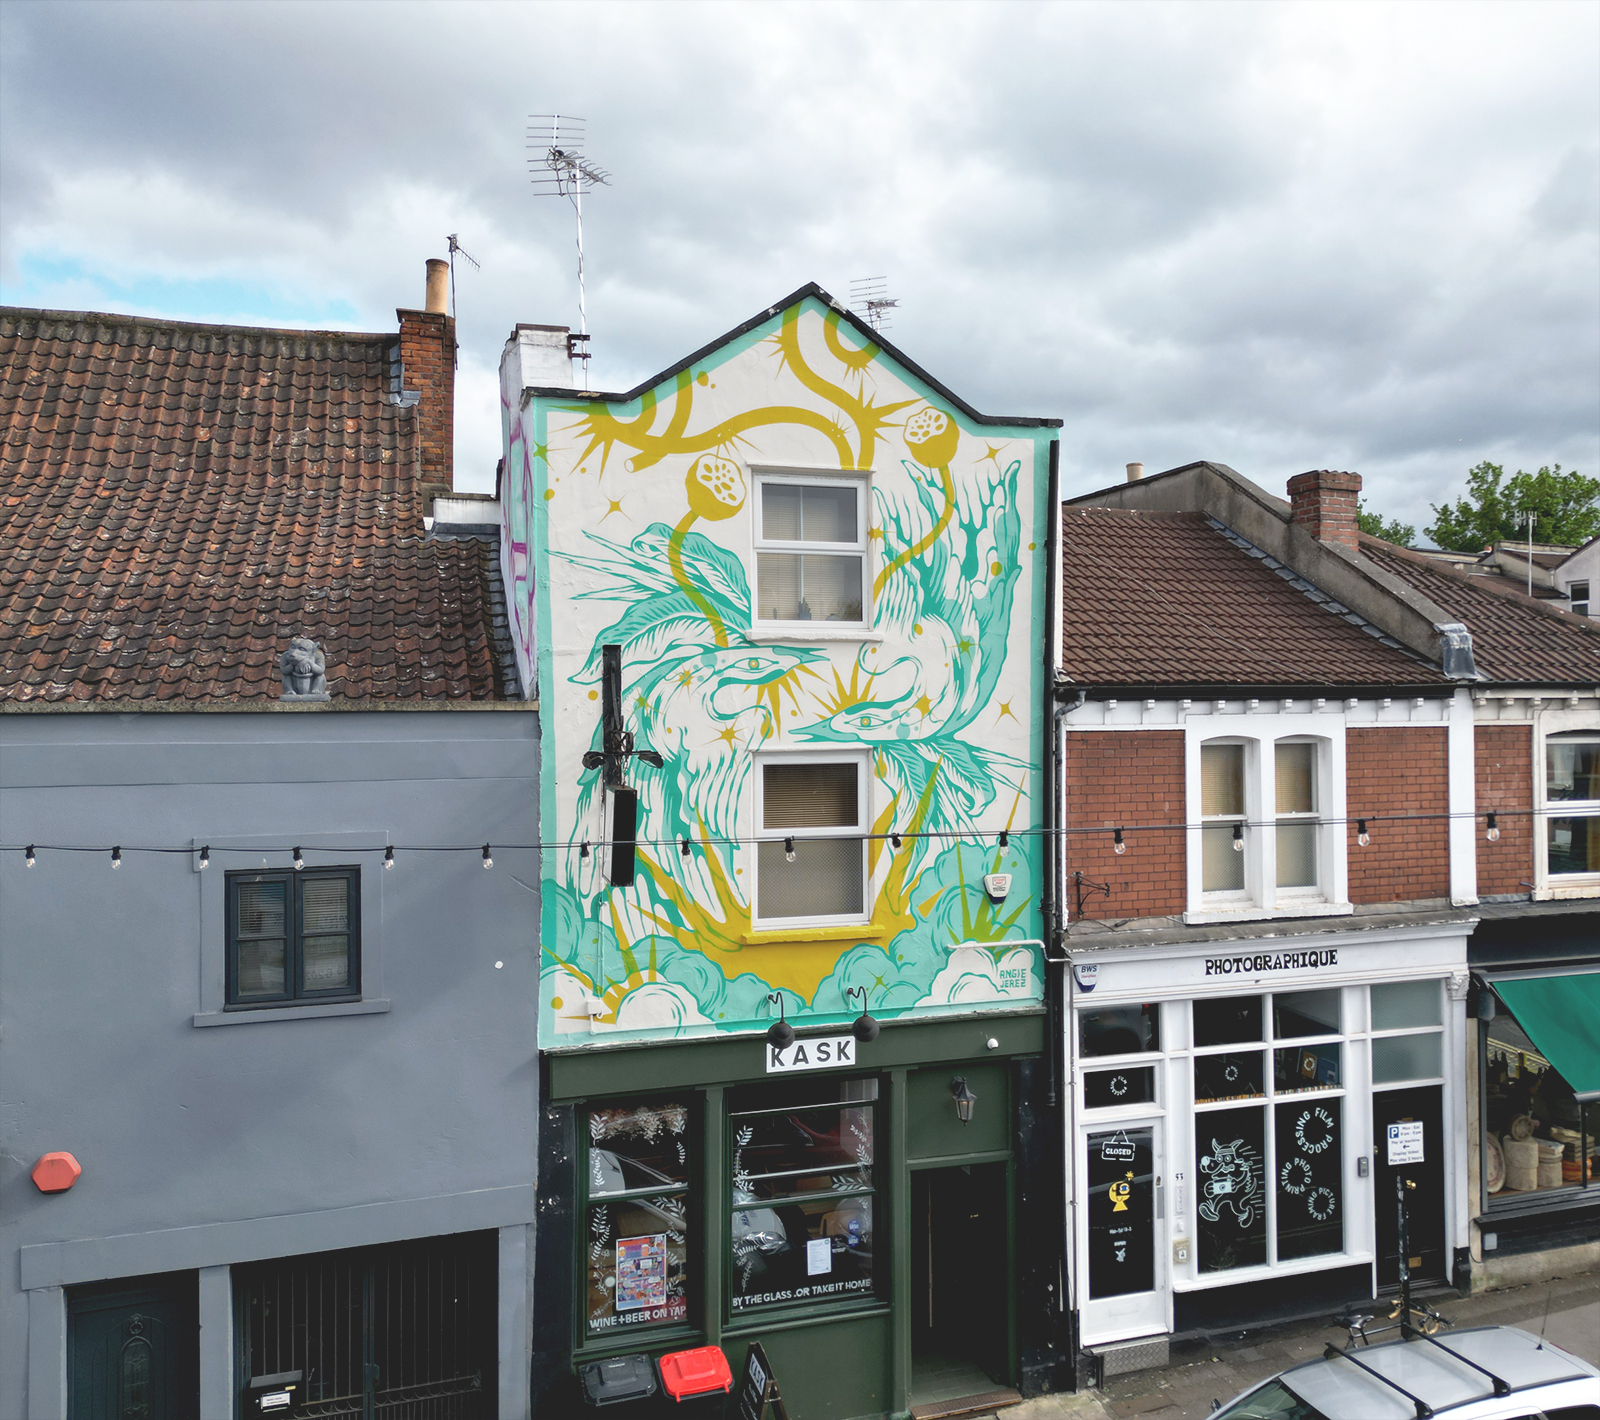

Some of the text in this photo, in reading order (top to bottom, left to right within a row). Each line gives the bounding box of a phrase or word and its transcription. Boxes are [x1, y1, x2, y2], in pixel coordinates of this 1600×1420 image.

[999, 968, 1027, 980] ANGIE
[1081, 965, 1098, 973] BWS
[1205, 949, 1338, 976] PHOTOGRAPHIQUE
[999, 979, 1026, 988] JEREZ
[771, 1040, 851, 1068] KASK
[1295, 1107, 1335, 1154] FILM PROCESSING
[1105, 1147, 1132, 1156] CLOSED
[1280, 1157, 1312, 1195] PHOTO PRINTING
[1307, 1187, 1336, 1221] PICTURE FRAMING
[732, 1297, 743, 1307] BY
[744, 1293, 762, 1305] THE
[763, 1290, 792, 1302] GLASS
[845, 1278, 871, 1290] HOME
[652, 1309, 668, 1319] ON
[669, 1305, 686, 1317] TAP
